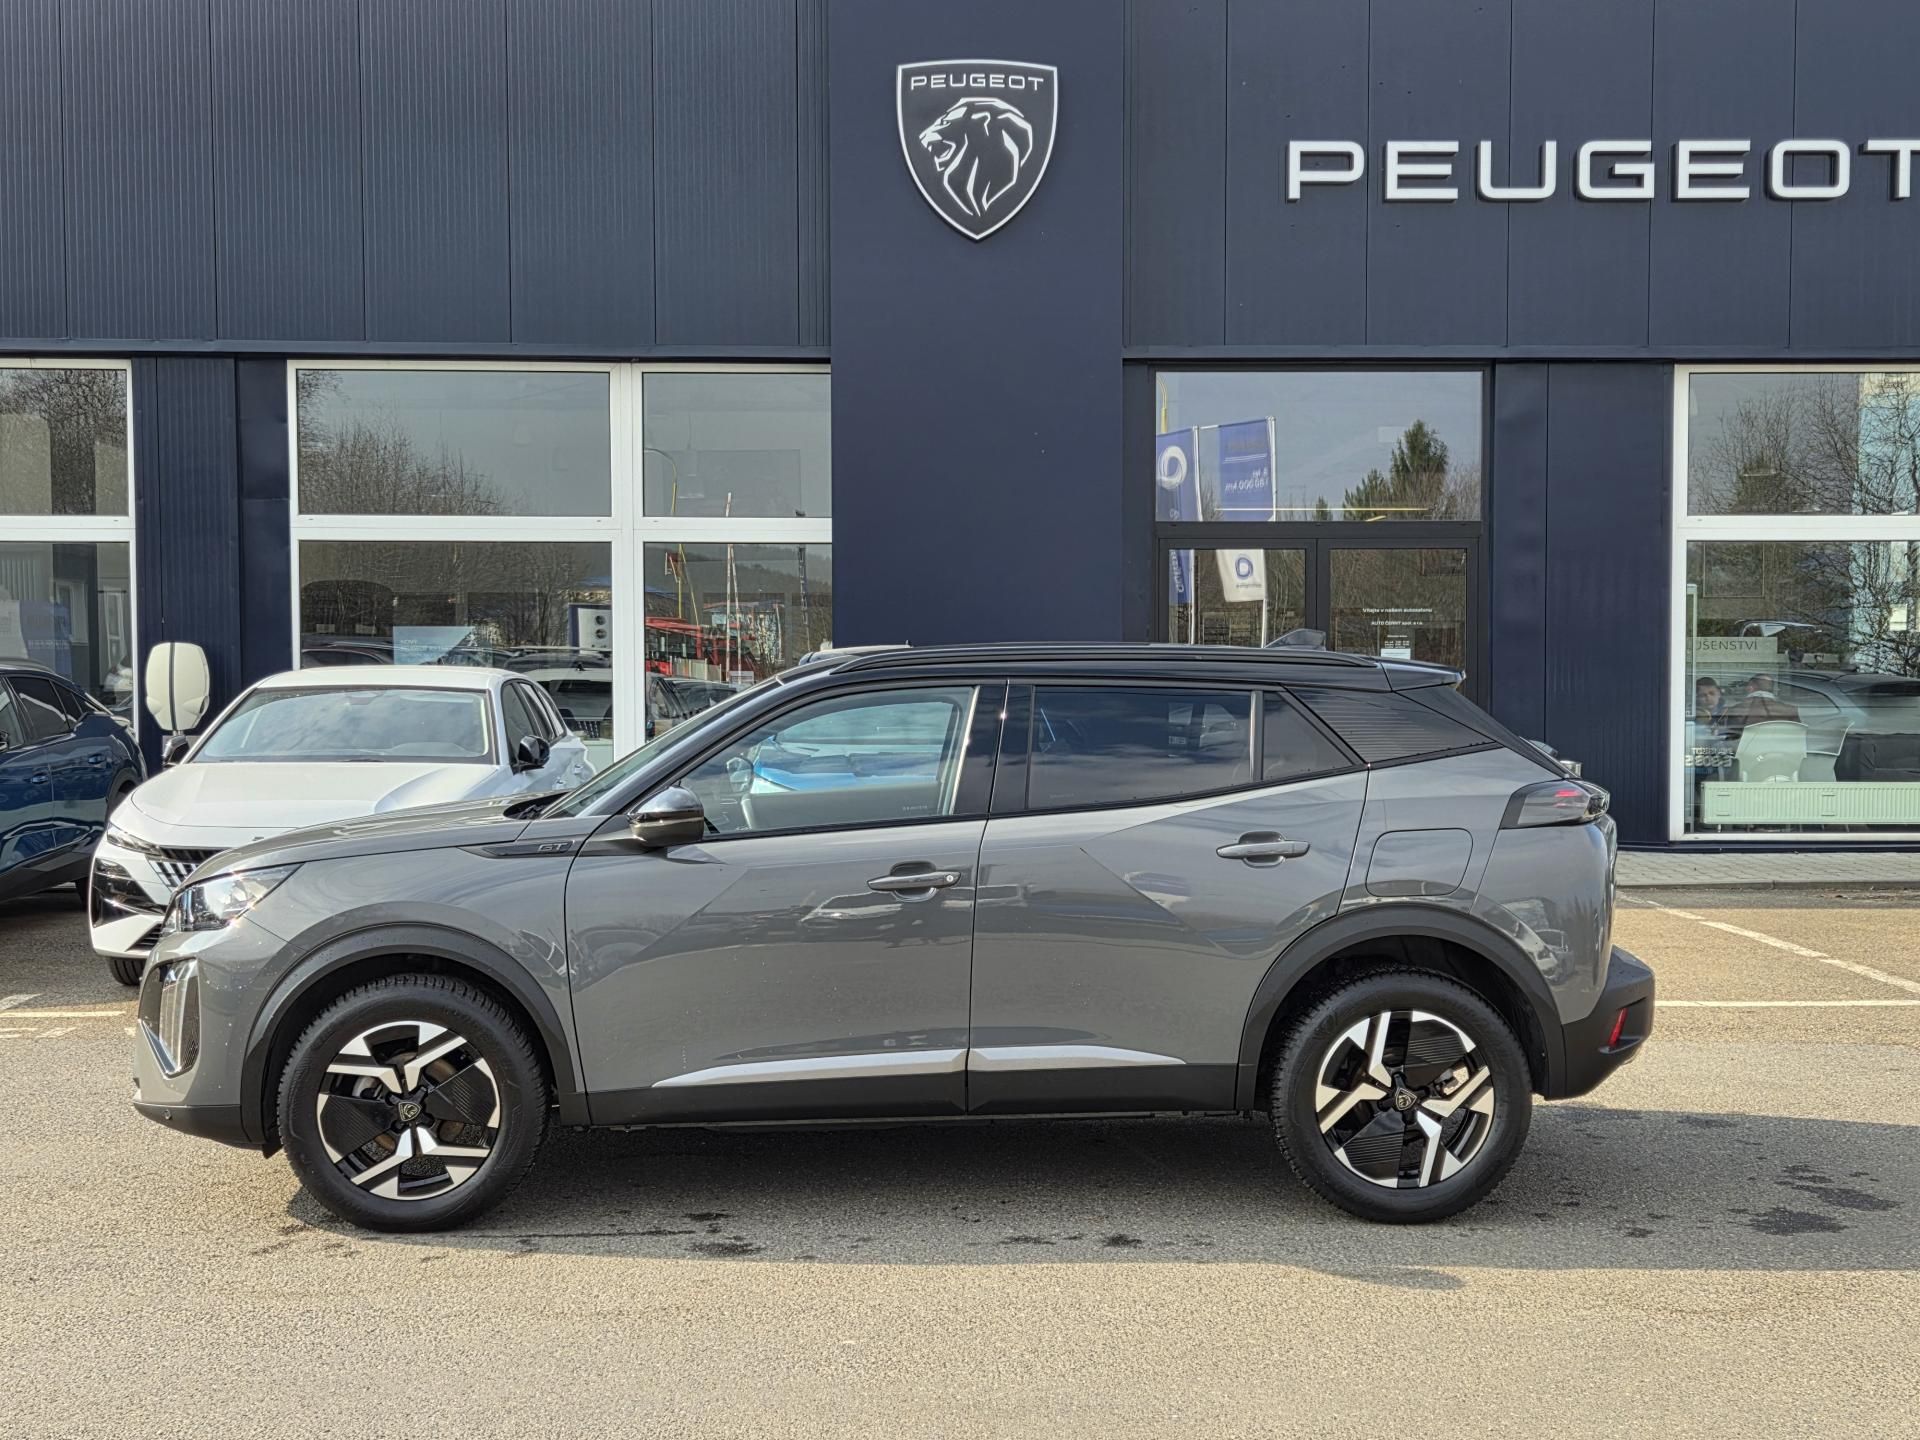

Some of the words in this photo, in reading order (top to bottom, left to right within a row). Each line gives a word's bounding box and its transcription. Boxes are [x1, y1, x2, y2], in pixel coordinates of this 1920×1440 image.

[910, 73, 1045, 91] PEUGEOT
[1286, 138, 1920, 203] PEUGEOT
[537, 842, 568, 852] GT
